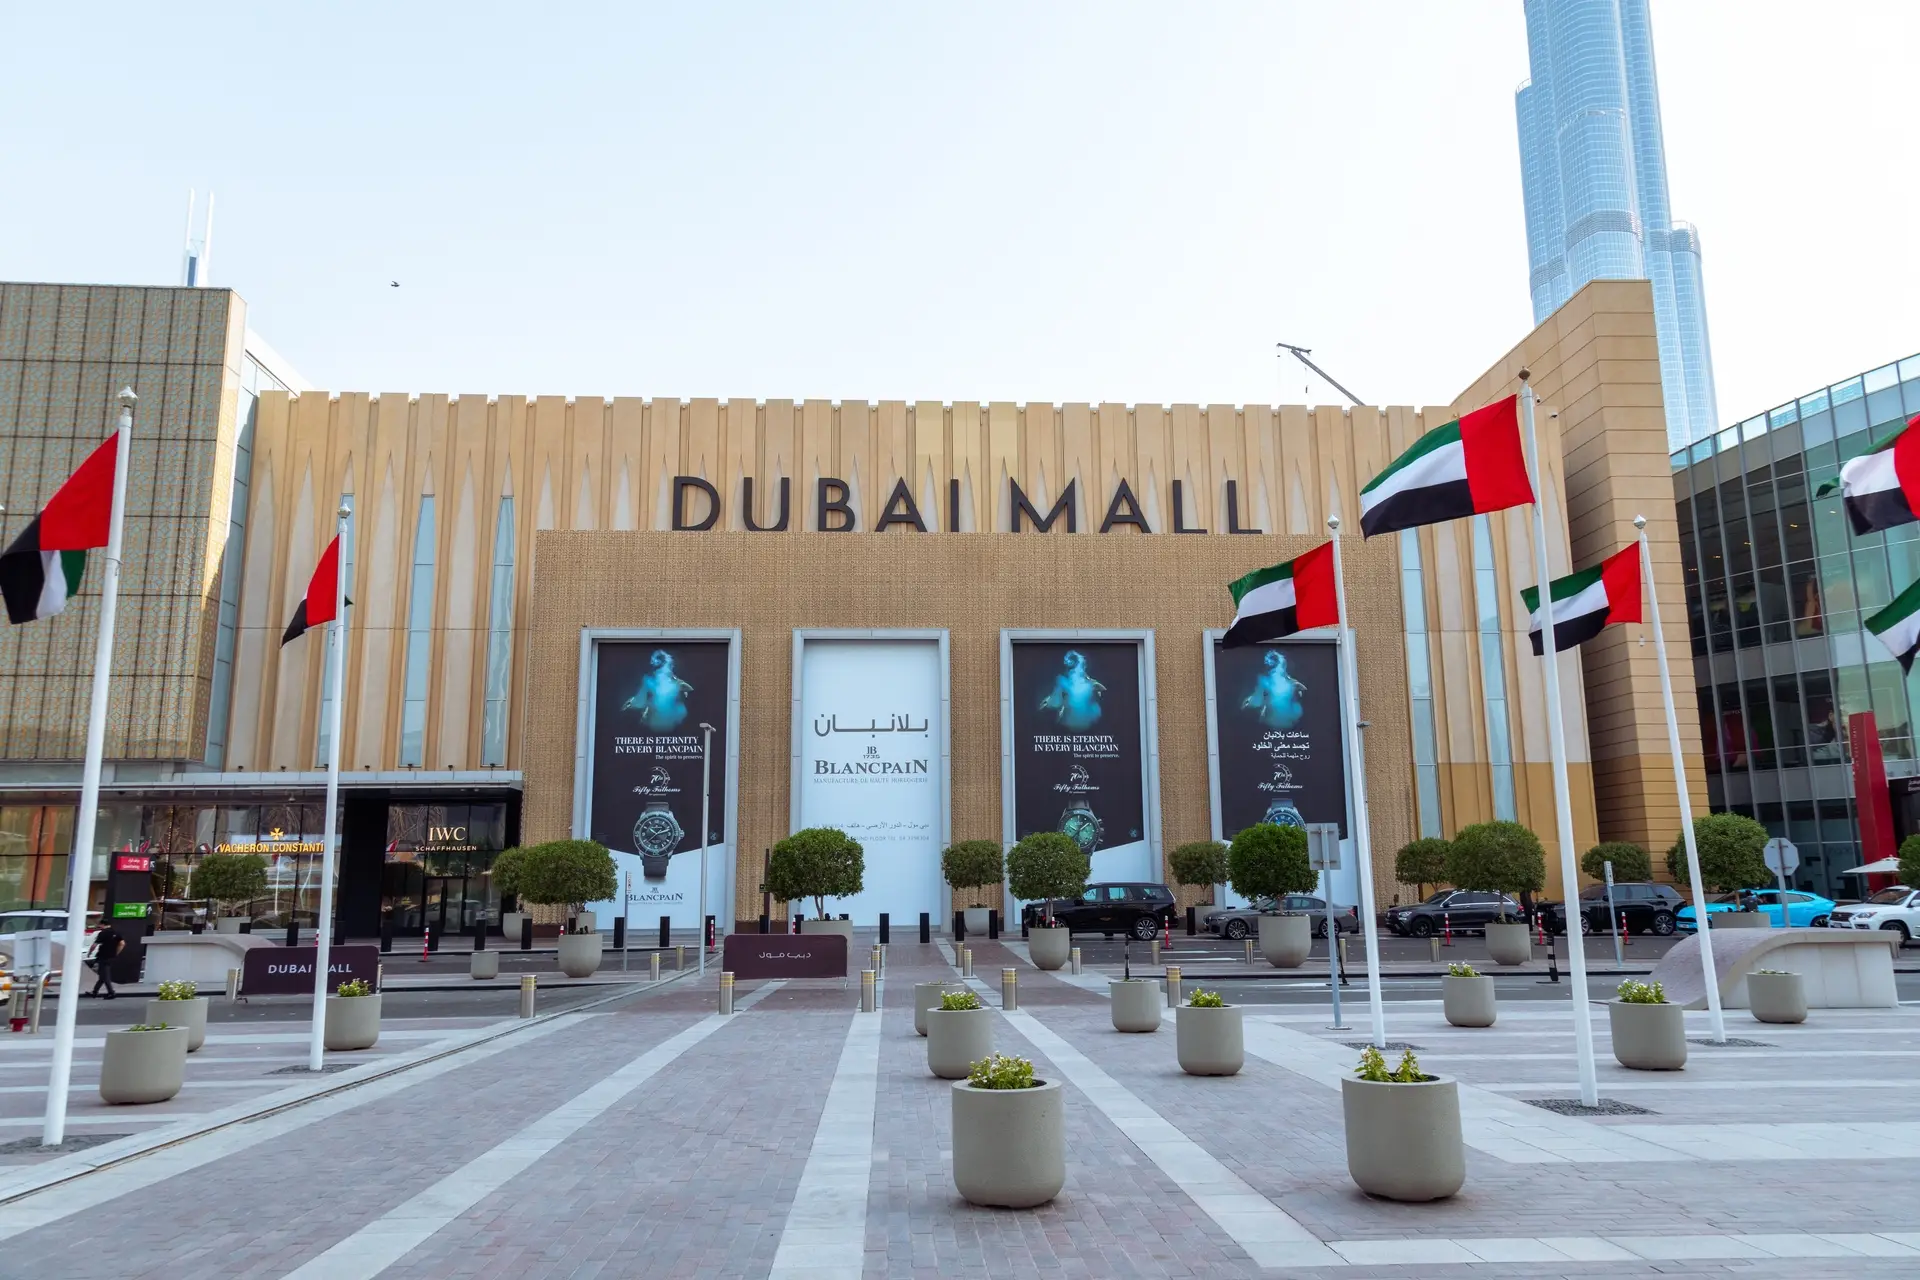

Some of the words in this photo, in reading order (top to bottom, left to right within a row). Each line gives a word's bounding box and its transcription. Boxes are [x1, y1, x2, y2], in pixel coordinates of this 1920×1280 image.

[672, 476, 959, 533] DUBAI
[1010, 477, 1263, 533] MALL
[615, 736, 644, 745] THERE
[646, 736, 655, 745] IS
[655, 736, 699, 745] ETERNITY
[1033, 735, 1062, 743] THERE
[1063, 735, 1072, 743] IS
[1073, 735, 1114, 743] ETERNITY
[1263, 731, 1285, 740] بلانبان
[615, 745, 625, 754] IN
[626, 745, 655, 754] EVERY
[655, 745, 703, 754] BLANCPAIN
[1034, 744, 1044, 752] IN
[1045, 744, 1071, 752] EVERY
[1073, 744, 1119, 752] BLANCPAIN
[1252, 741, 1273, 751] الخلود
[1273, 741, 1291, 752] معنى
[1292, 742, 1310, 751] تجسد
[814, 759, 928, 774] BLANCPAIN
[632, 785, 652, 795] Fifty
[652, 785, 681, 793] Fathoms
[1053, 783, 1071, 793] Fifty
[1257, 782, 1275, 792] Fifty
[428, 826, 466, 842] IWC
[219, 843, 270, 853] VACHERON
[272, 842, 325, 853] CONSTANTI
[268, 964, 312, 974] DUBAI
[316, 963, 353, 973] ALL
